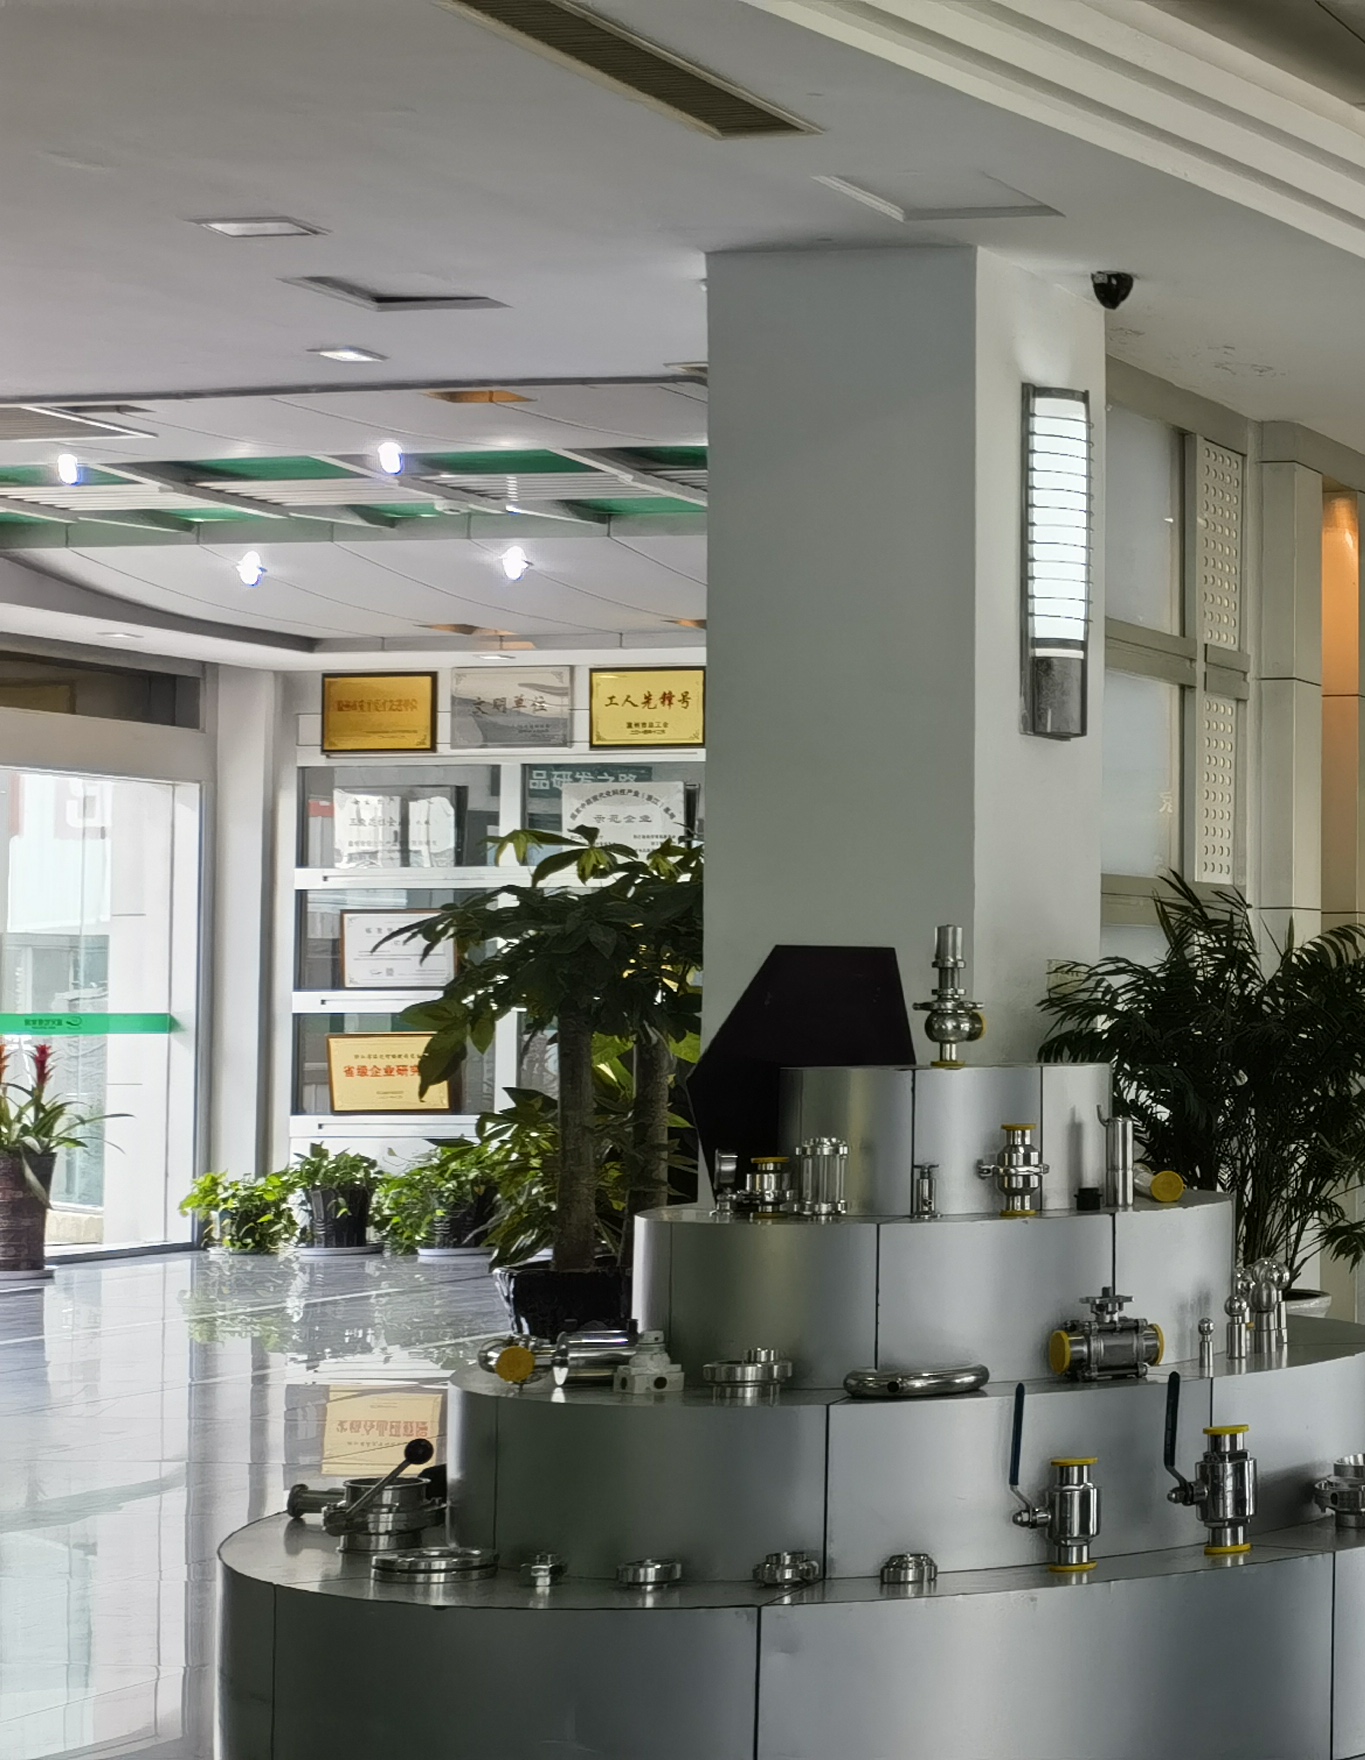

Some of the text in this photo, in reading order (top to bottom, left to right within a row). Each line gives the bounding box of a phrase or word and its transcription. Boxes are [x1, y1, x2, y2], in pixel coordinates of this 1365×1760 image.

[604, 690, 692, 710] 工人先锋号
[593, 814, 653, 824] 示范企业
